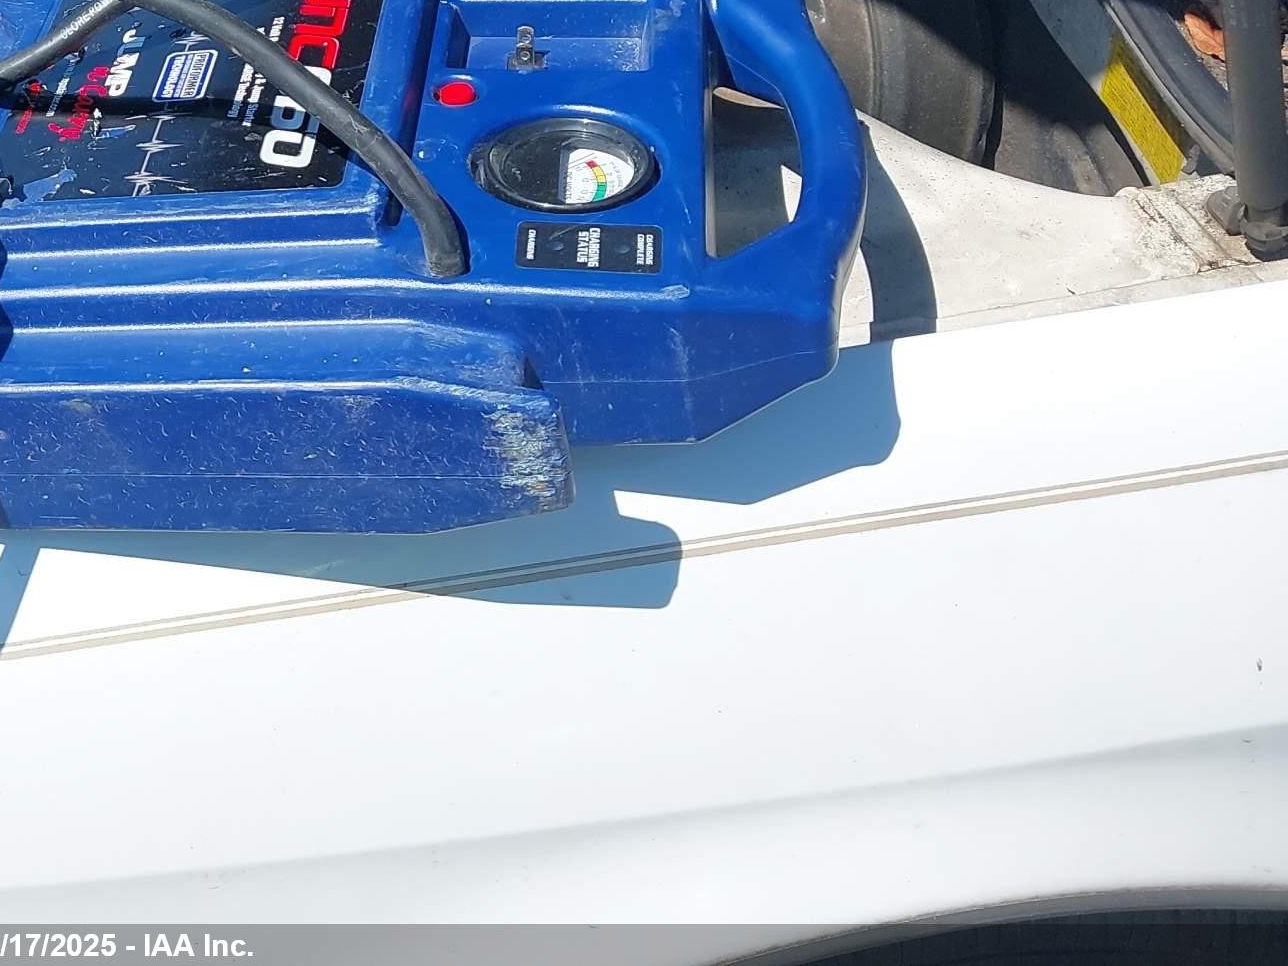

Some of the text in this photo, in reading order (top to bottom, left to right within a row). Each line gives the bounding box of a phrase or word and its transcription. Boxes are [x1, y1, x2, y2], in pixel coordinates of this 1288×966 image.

[108, 28, 147, 97] JUMP
[576, 231, 589, 263] STATUS
[587, 227, 601, 267] CHARGING
